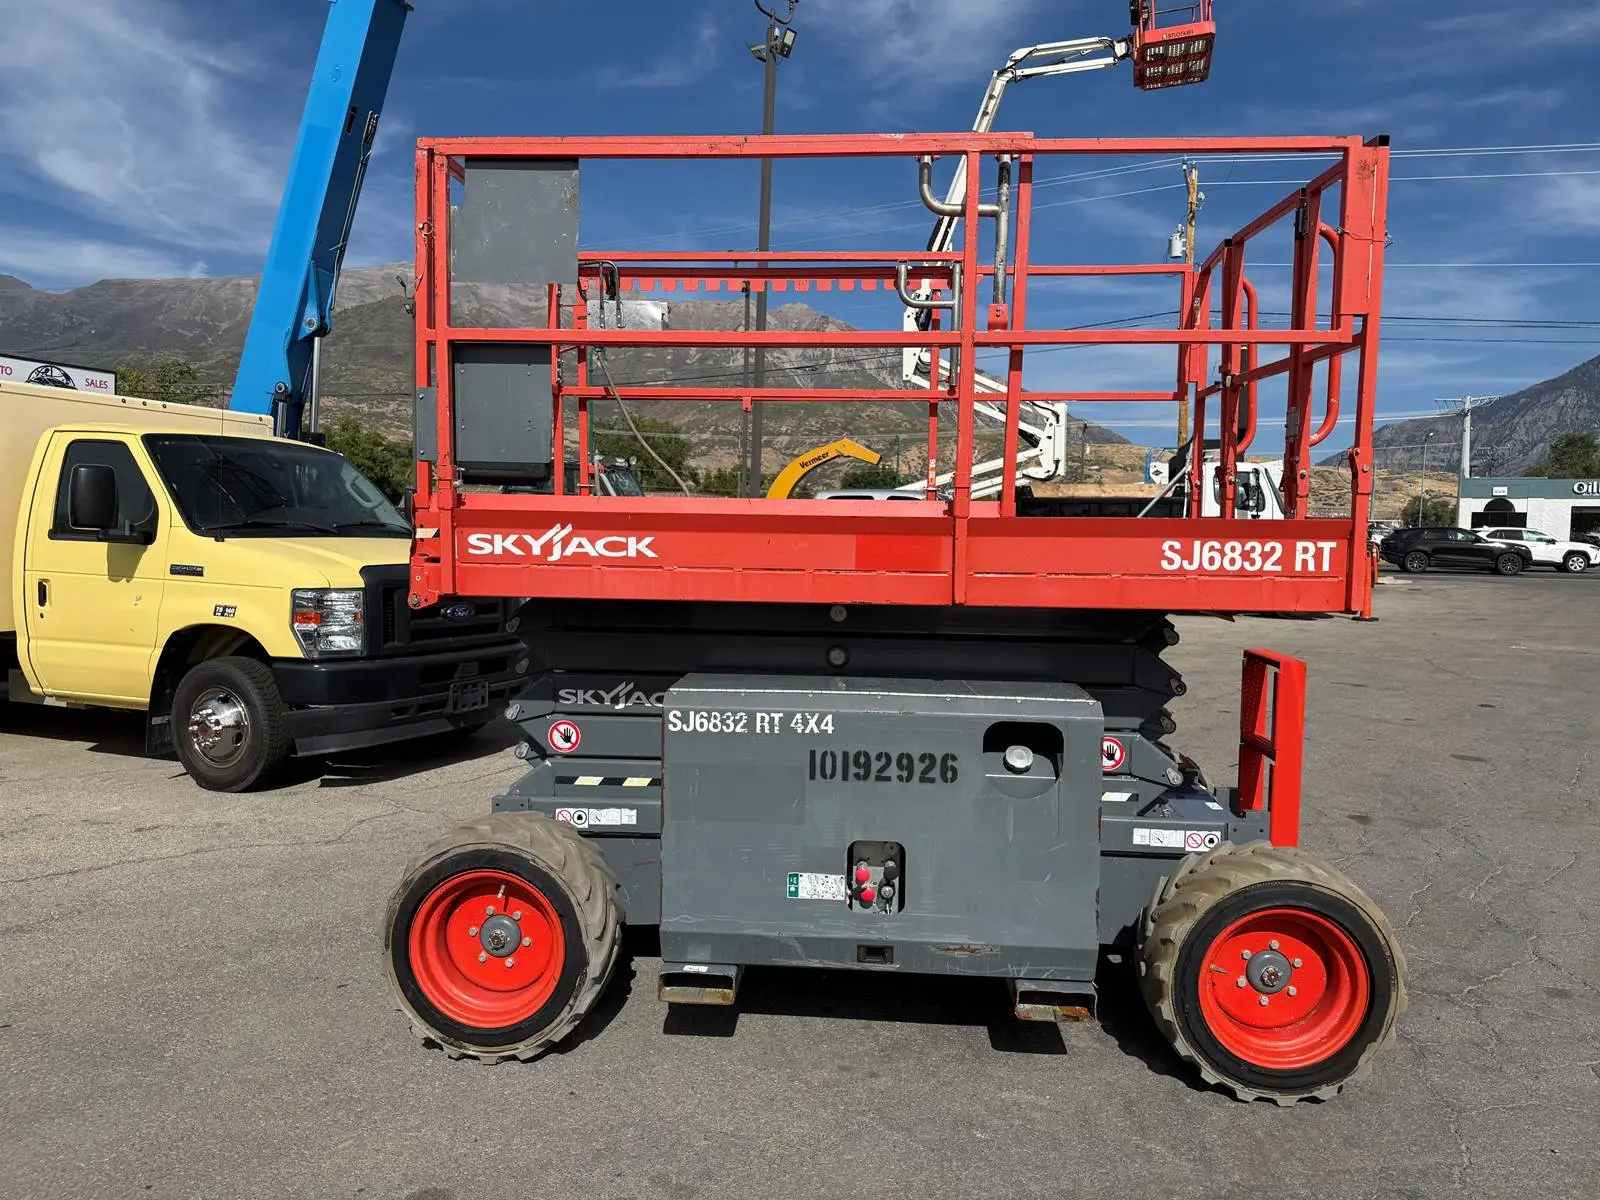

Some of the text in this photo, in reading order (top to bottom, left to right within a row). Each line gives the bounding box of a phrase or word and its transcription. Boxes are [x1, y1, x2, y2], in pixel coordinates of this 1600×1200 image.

[85, 378, 108, 389] SALES
[799, 451, 830, 469] Vermeer
[1573, 481, 1600, 494] Oil
[467, 523, 660, 561] SKYJACK
[1160, 540, 1337, 572] SJ6832 RT
[668, 710, 835, 734] SJ6832 RT 4X4
[809, 750, 959, 784] 10192926
